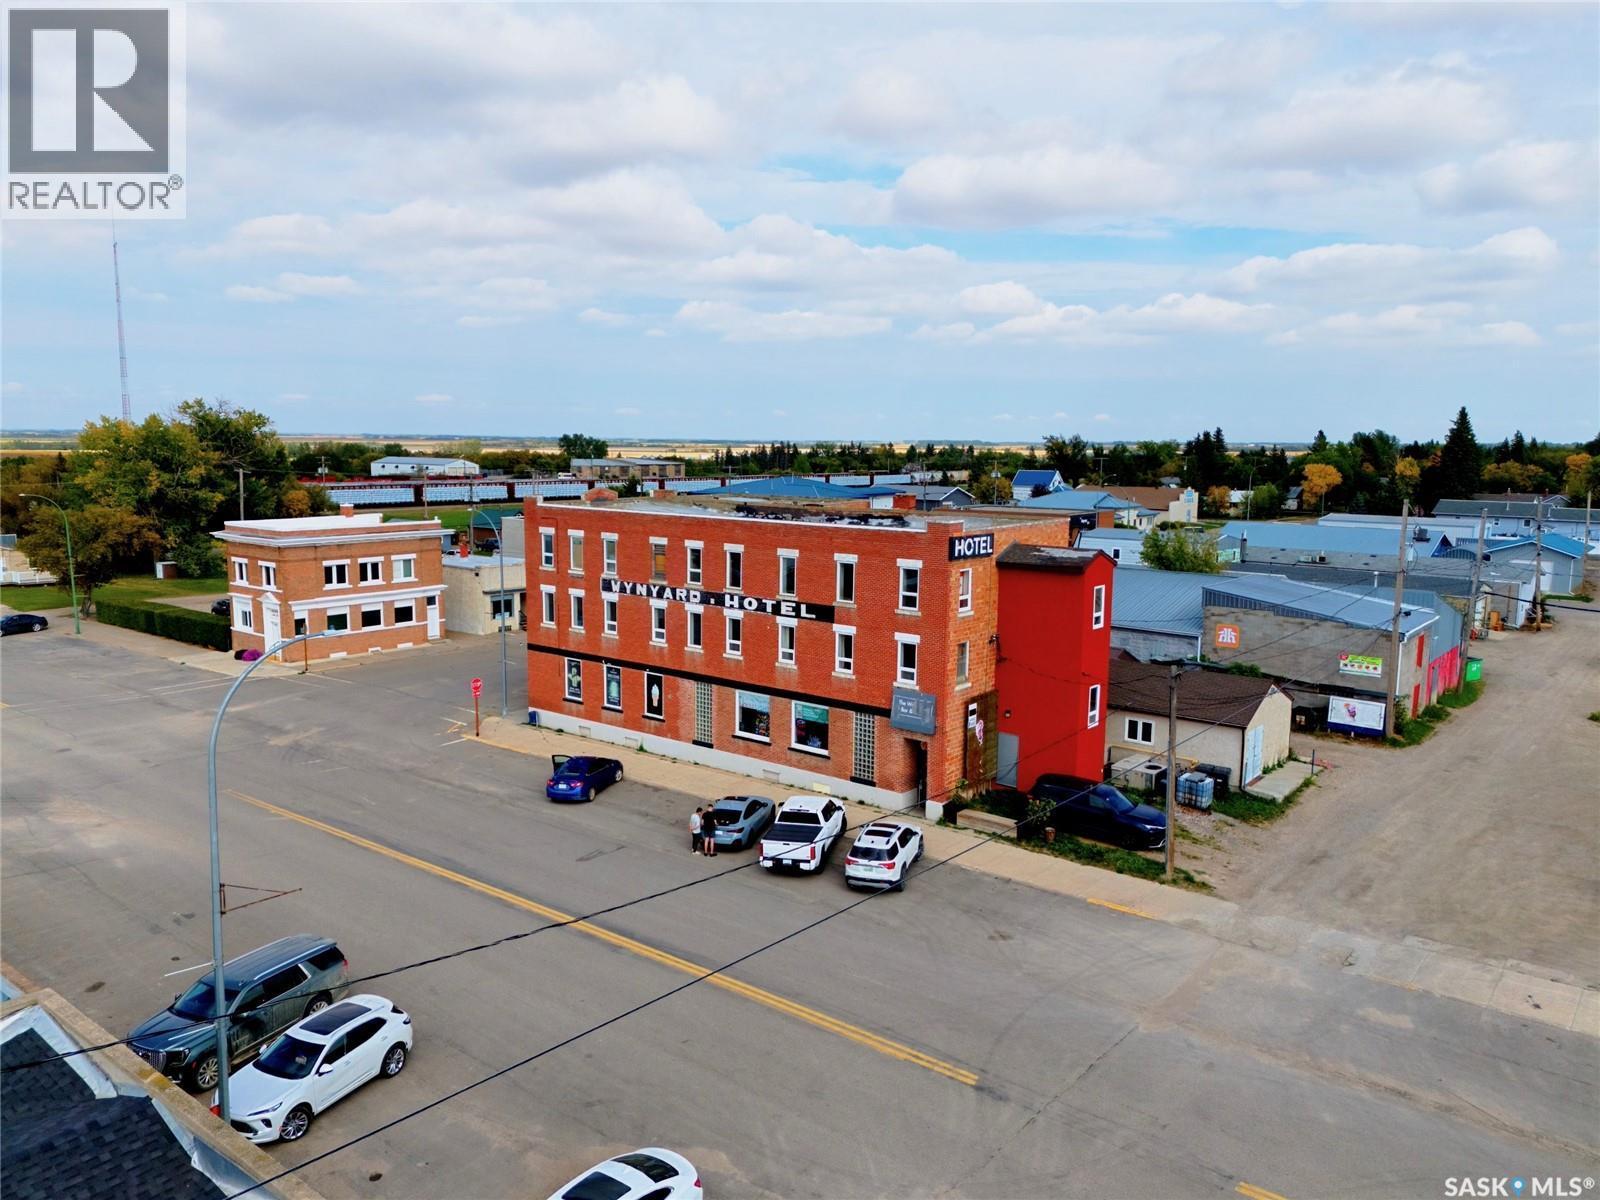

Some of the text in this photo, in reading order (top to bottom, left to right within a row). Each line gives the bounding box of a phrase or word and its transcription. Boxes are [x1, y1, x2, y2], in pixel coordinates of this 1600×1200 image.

[954, 535, 993, 557] HOTEL
[611, 579, 816, 618] WYNYARD HOTEL
